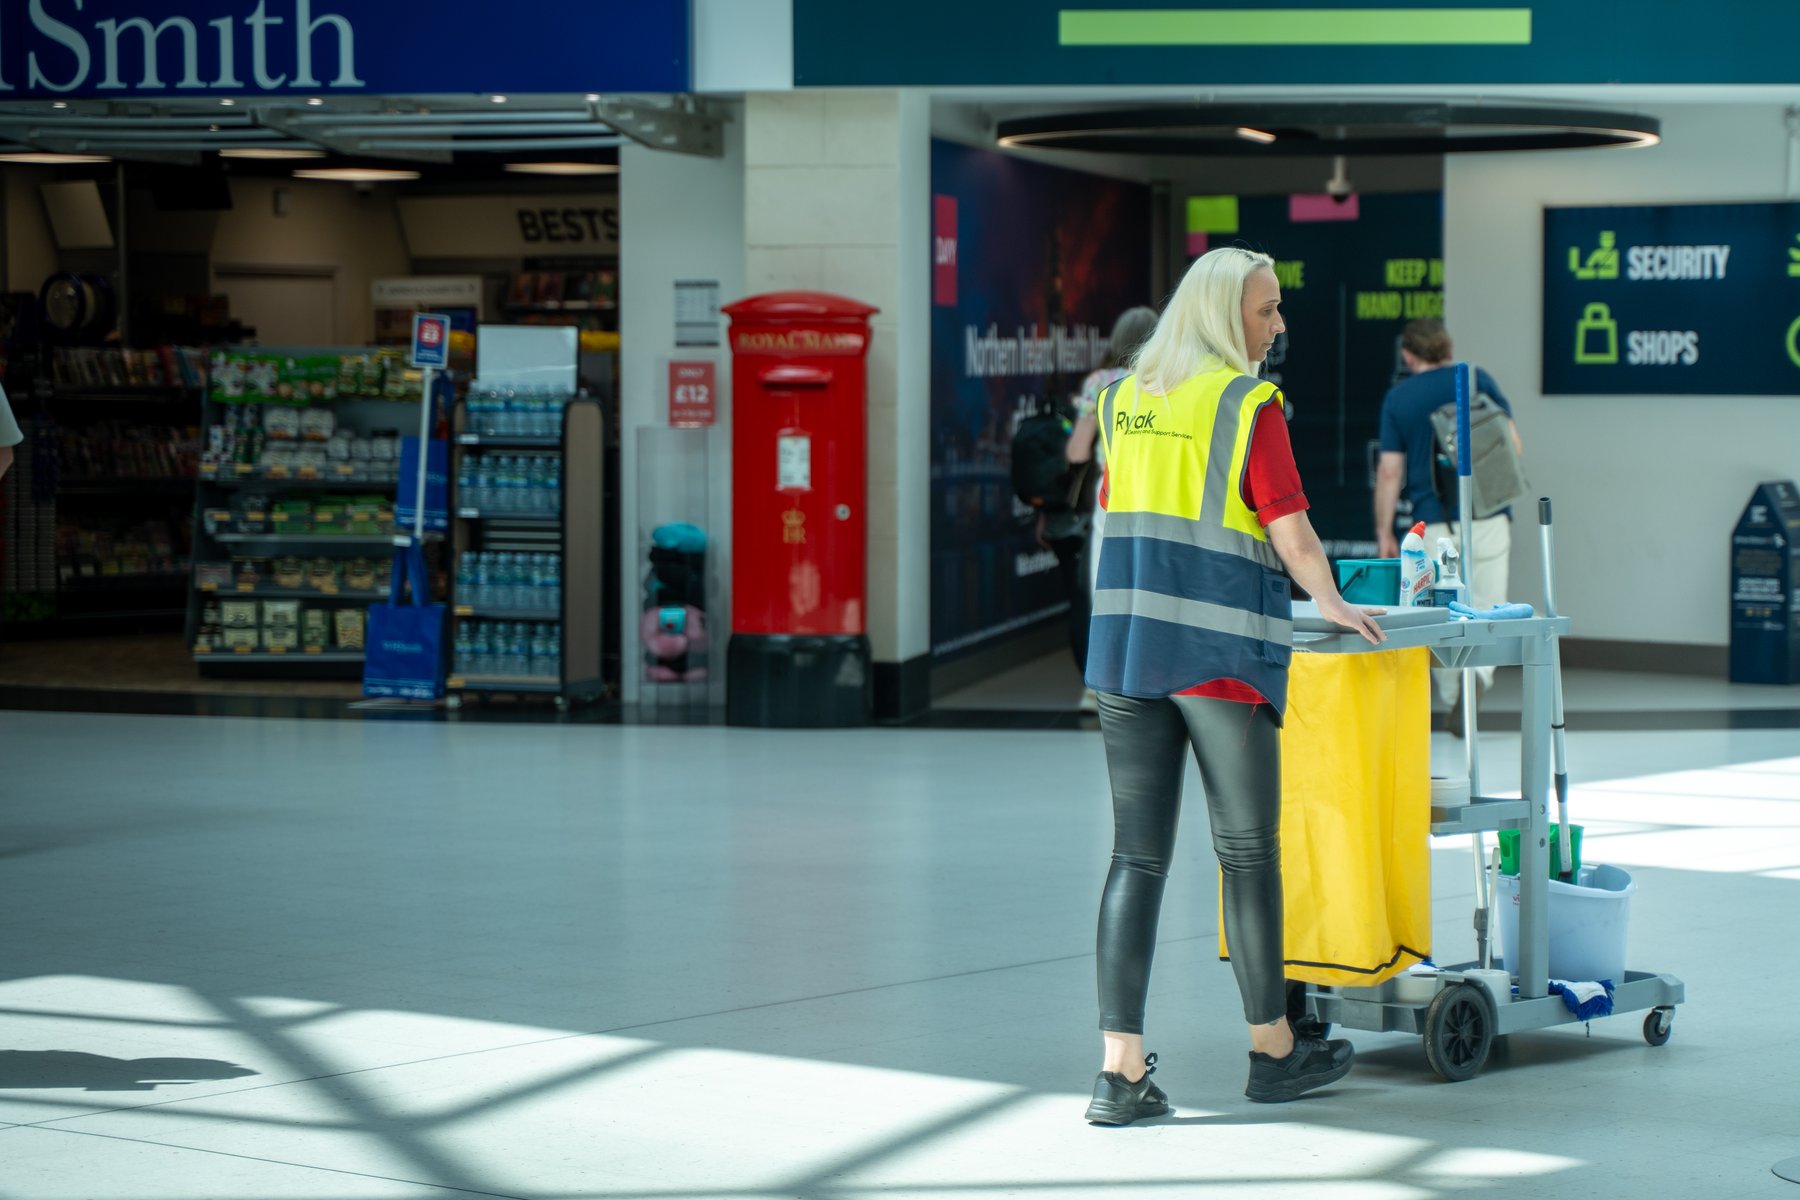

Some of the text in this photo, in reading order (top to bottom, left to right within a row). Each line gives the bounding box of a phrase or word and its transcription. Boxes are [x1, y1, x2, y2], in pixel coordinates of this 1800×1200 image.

[0, 0, 366, 92] Smith
[516, 207, 619, 242] BESTS
[1274, 261, 1304, 289] OVE
[1386, 259, 1427, 287] KEEP
[1627, 245, 1730, 280] SECURITY
[1356, 292, 1402, 319] HAND
[738, 332, 796, 349] ROYAL
[965, 321, 1018, 377] Northern
[1019, 321, 1055, 376] Ireland
[1627, 330, 1699, 365] SHOPS
[675, 384, 709, 403] £12
[1115, 410, 1157, 435] Ryak
[1151, 429, 1171, 437] Support
[1171, 431, 1193, 440] Services
